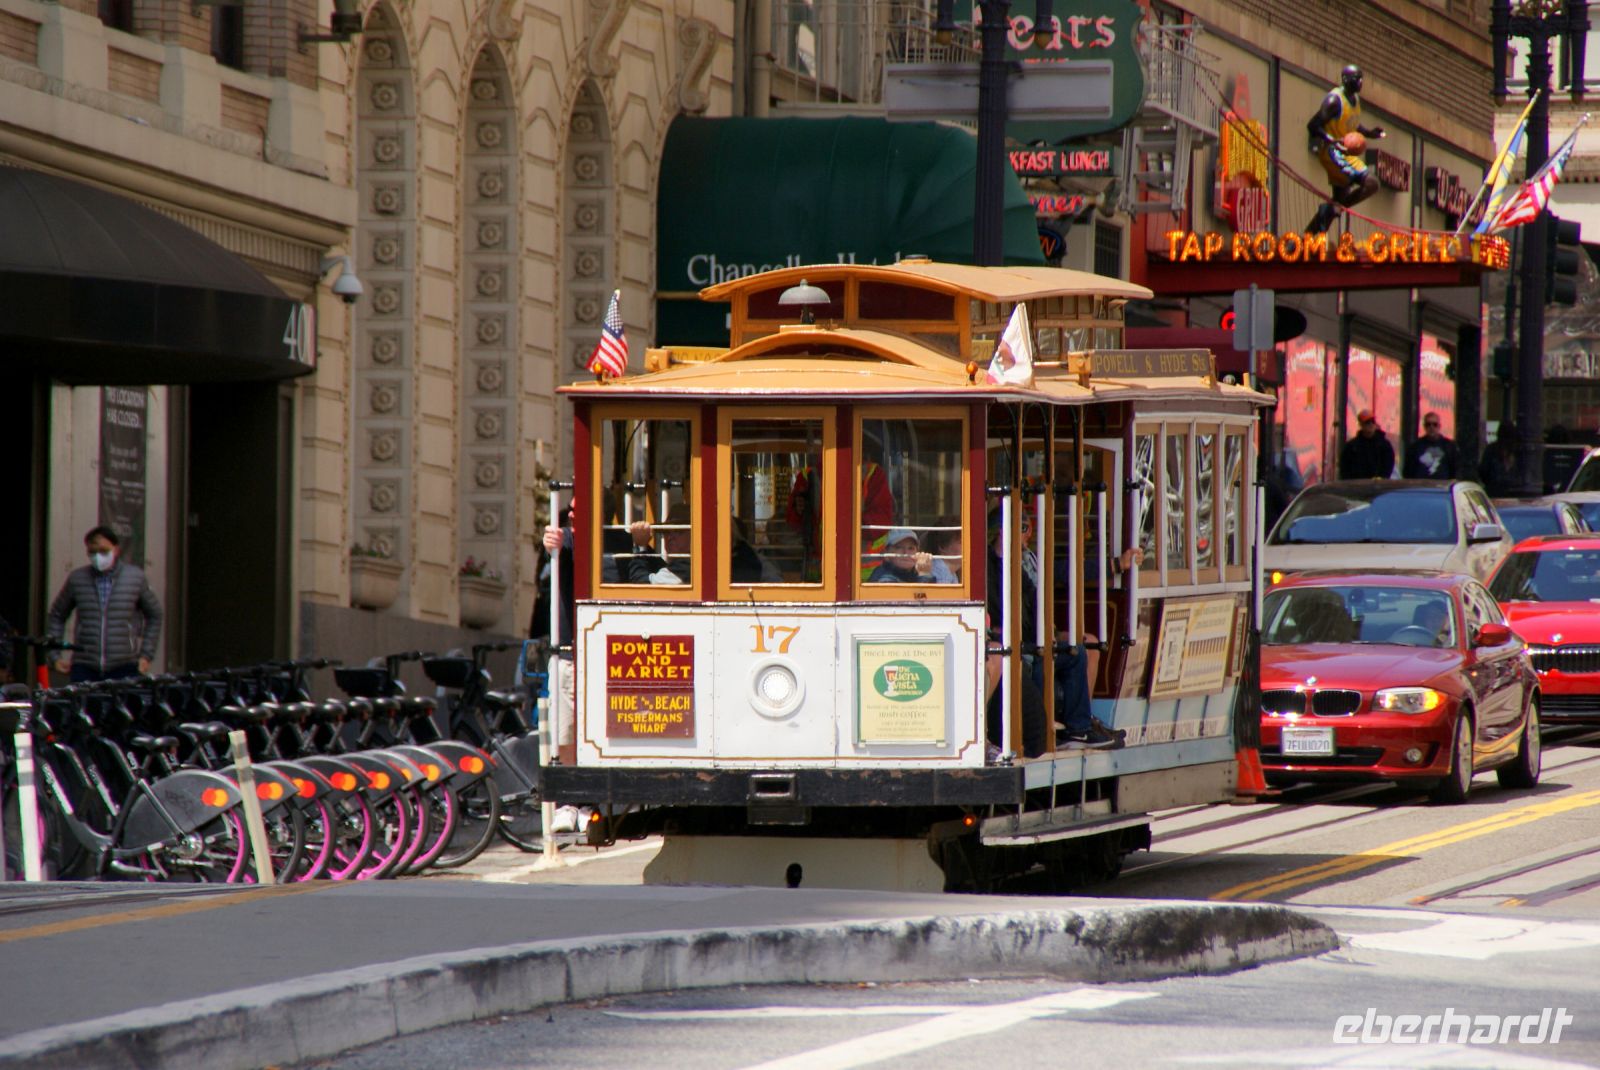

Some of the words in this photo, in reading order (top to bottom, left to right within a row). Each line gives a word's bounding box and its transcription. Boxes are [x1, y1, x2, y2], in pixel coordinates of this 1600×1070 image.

[976, 10, 1116, 50] ears
[1061, 150, 1110, 171] LUNCH
[1236, 187, 1266, 232] GRILL
[1164, 230, 1224, 262] TAP
[1231, 231, 1328, 262] ROOM
[1336, 232, 1356, 262] &
[1366, 231, 1458, 263] GRILL
[1095, 354, 1137, 373] POWELL
[1160, 353, 1188, 372] HYDE
[749, 625, 801, 654] 17
[611, 642, 690, 656] POWELL
[633, 656, 671, 666] AND
[610, 666, 692, 679] MARKET
[610, 695, 637, 710] HYDE
[655, 695, 691, 710] BEACH
[616, 712, 683, 723] FISHERMANS
[632, 723, 666, 733] WHARF
